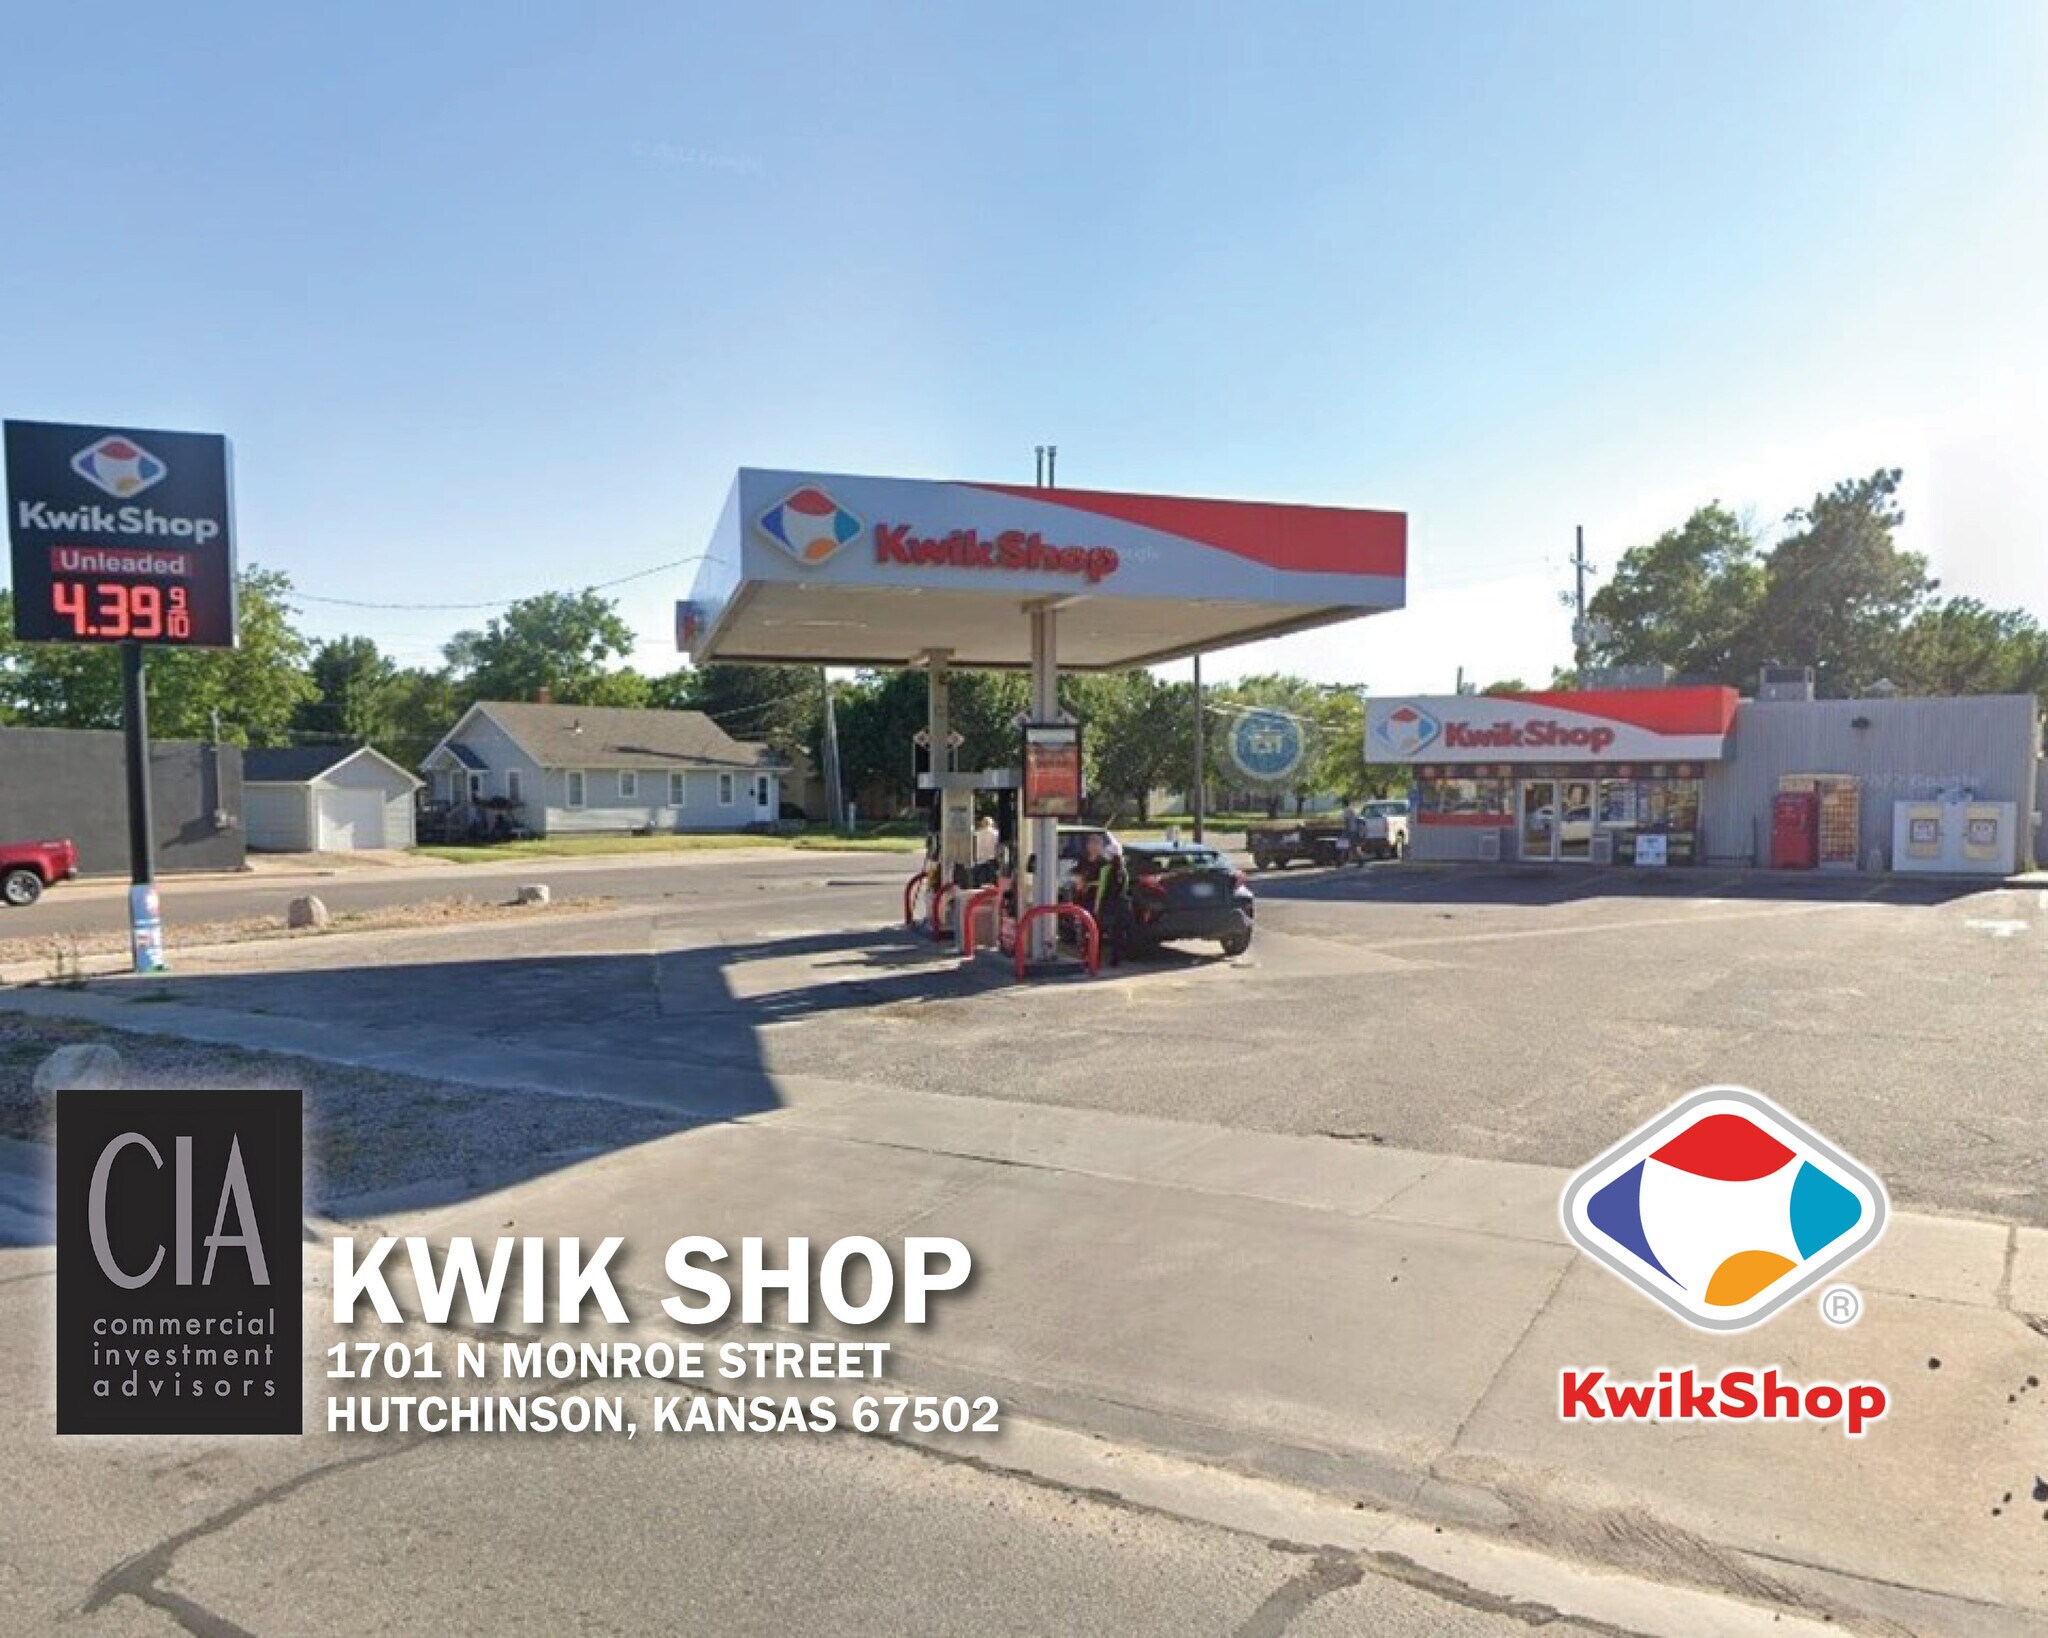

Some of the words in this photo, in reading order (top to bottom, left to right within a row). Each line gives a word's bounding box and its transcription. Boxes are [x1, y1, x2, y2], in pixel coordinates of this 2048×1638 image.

[18, 500, 219, 544] KwikShop
[61, 550, 185, 575] Unleaded
[874, 522, 1119, 582] KwikShop
[53, 583, 162, 637] 4.39
[1444, 719, 1615, 753] KwikShop
